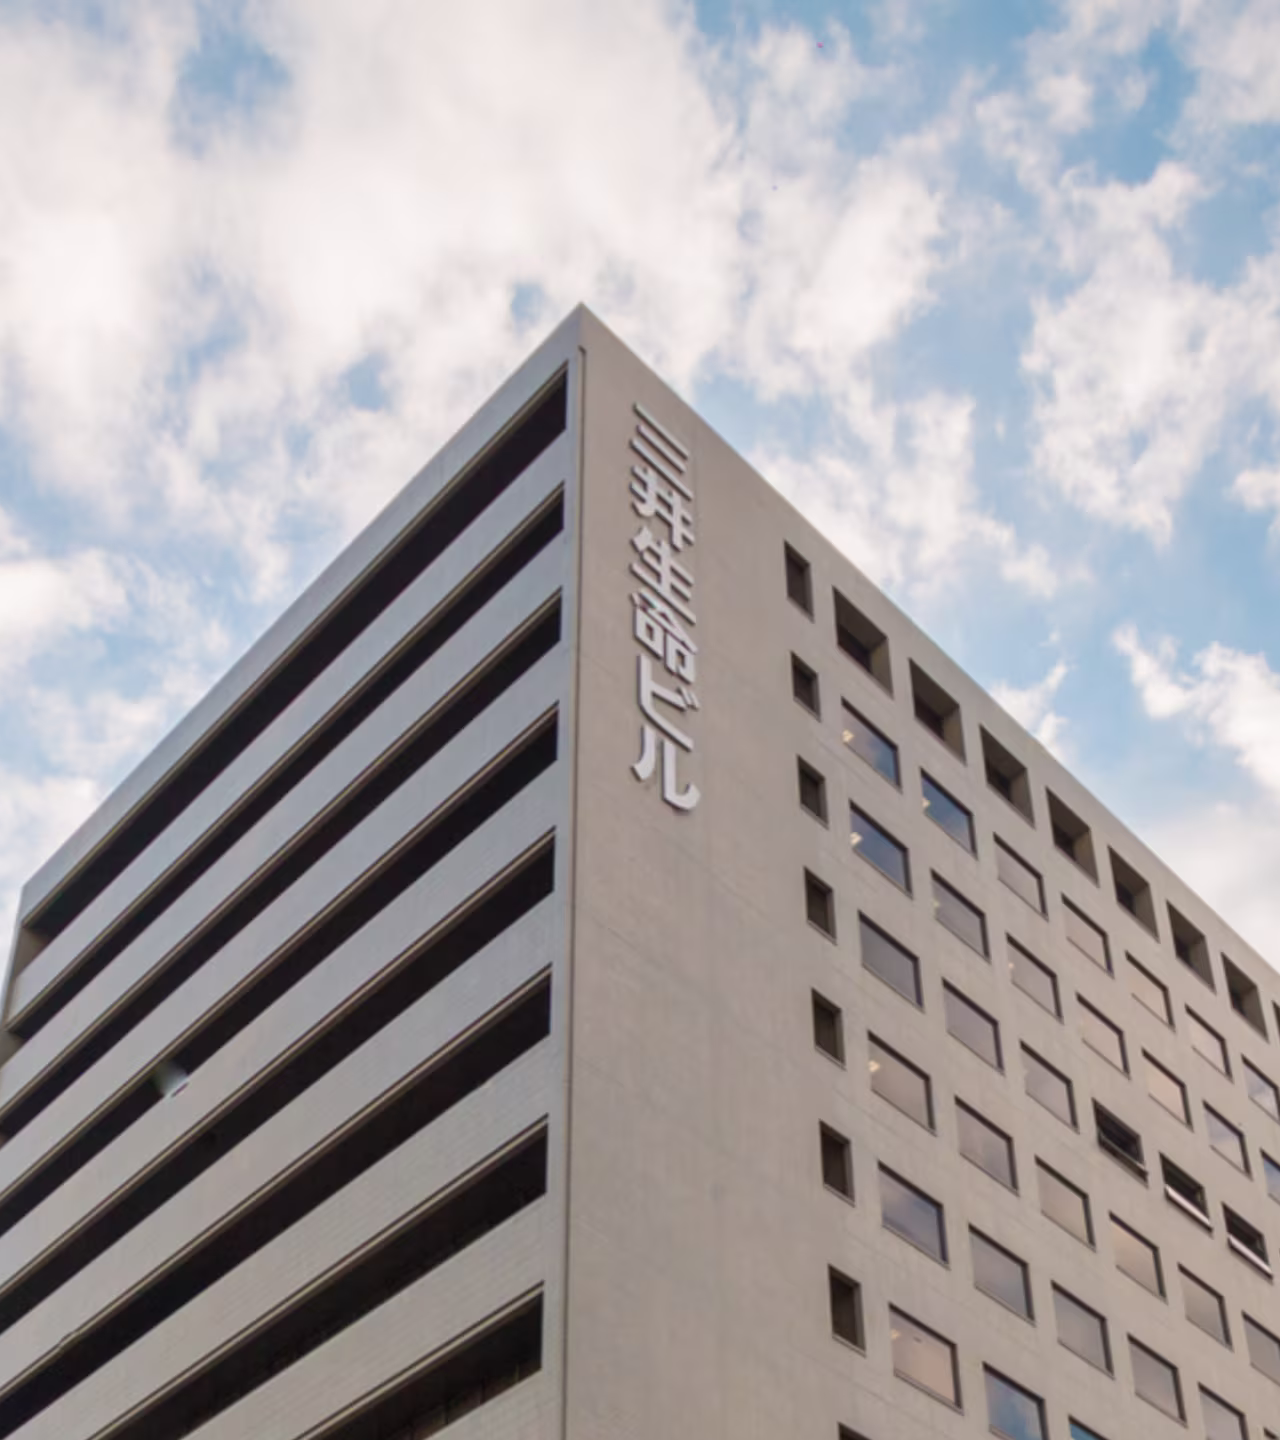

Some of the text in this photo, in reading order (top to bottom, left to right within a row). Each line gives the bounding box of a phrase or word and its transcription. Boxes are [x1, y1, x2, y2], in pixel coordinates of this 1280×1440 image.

[629, 401, 701, 812] 三井生命ビル
